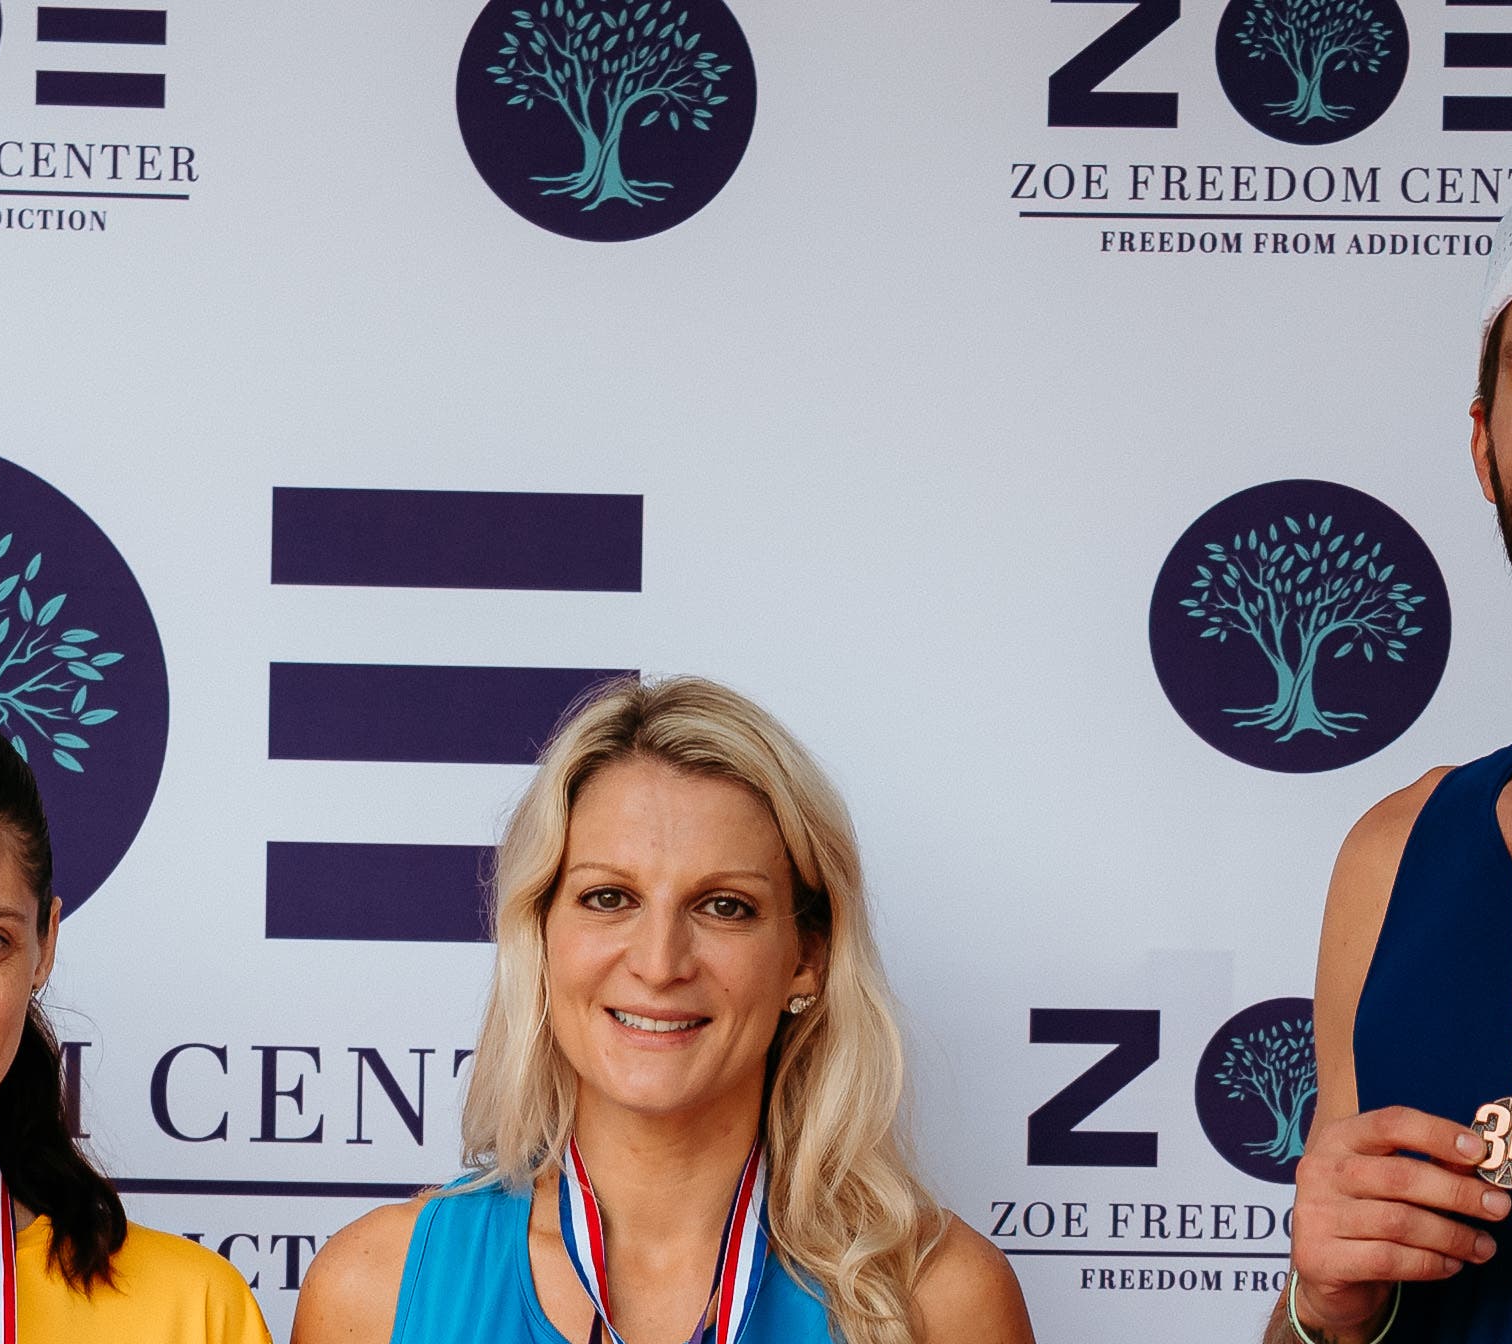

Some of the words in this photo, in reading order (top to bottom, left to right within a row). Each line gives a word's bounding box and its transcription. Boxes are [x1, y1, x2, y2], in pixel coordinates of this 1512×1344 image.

[1009, 162, 1110, 201] ZOE
[1127, 163, 1383, 204] FREEDOM
[1099, 230, 1244, 255] FREEDOM
[1252, 231, 1337, 256] FROM
[1344, 232, 1493, 257] ADDICTIO
[1027, 997, 1317, 1185] ZO
[989, 1200, 1090, 1239] ZOE
[1107, 1202, 1292, 1241] FREED
[1079, 1267, 1224, 1292] FREEDOM
